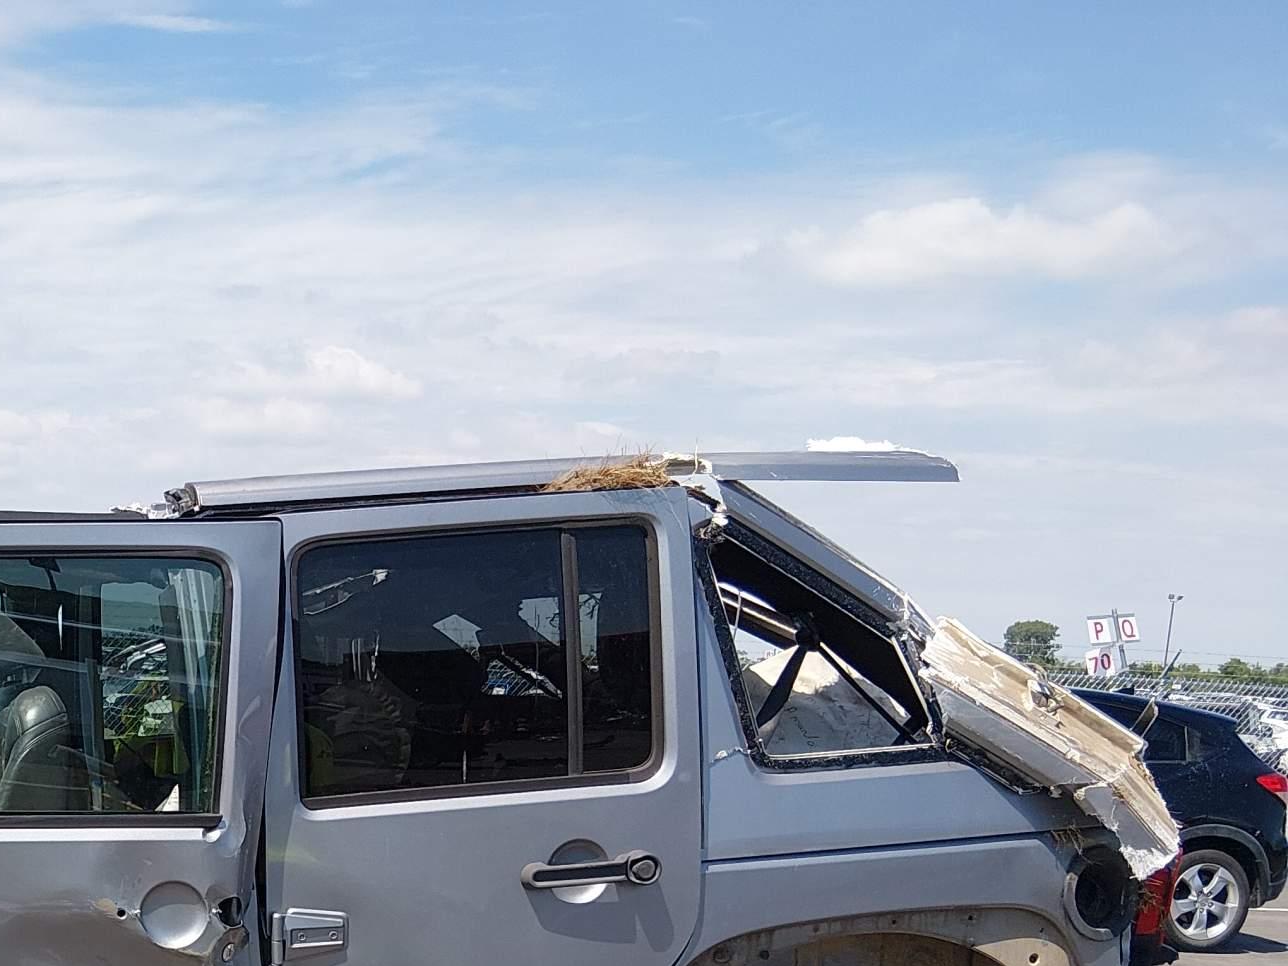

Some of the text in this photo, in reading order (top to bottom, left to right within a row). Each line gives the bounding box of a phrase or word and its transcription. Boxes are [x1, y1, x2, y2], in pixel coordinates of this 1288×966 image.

[1093, 621, 1104, 641] P
[1121, 619, 1136, 638] Q
[1088, 653, 1111, 674] 70
